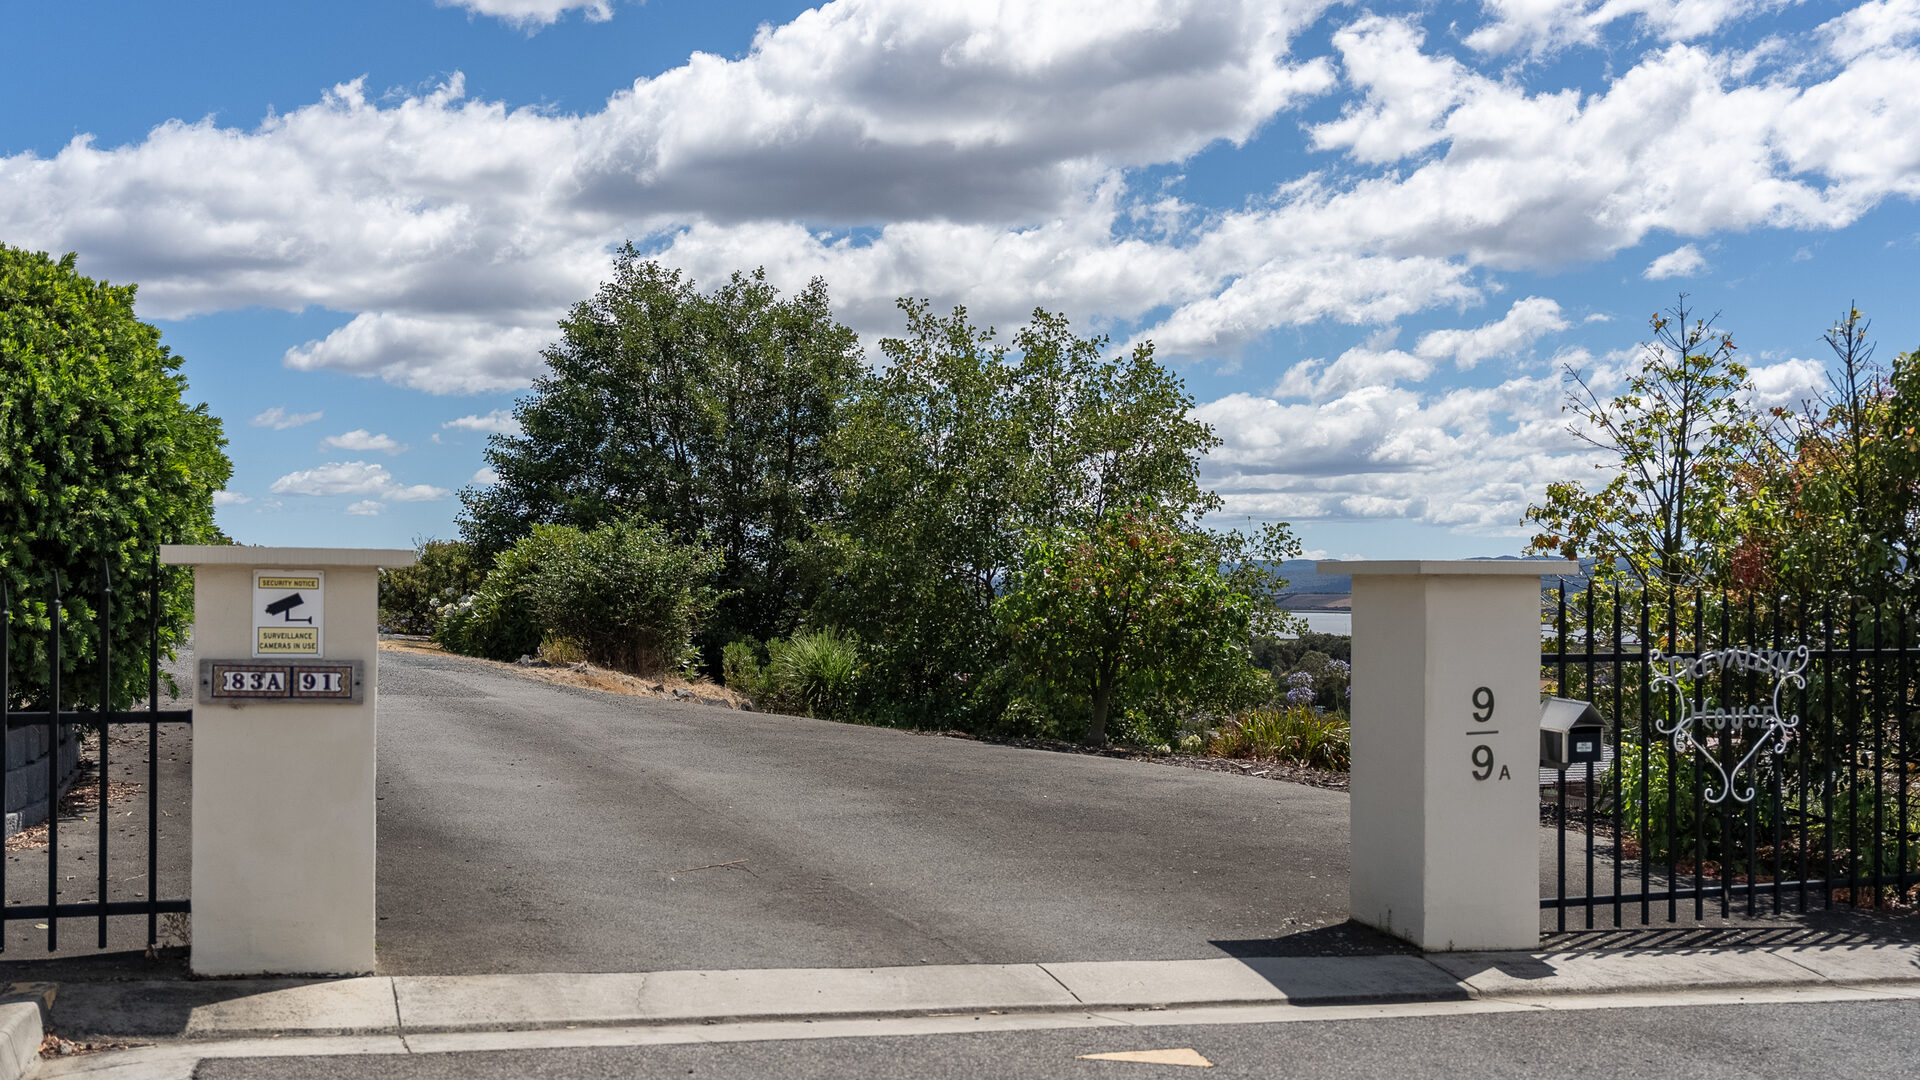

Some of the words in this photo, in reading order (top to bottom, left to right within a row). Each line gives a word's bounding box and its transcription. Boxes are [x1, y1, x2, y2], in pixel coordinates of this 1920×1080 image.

[263, 632, 313, 640] SURVEILLANCE
[259, 642, 291, 650] CAMERAS
[293, 642, 301, 650] IN
[302, 642, 316, 650] USE
[1661, 645, 1796, 683] TREVALLYN
[231, 673, 281, 690] 83A
[303, 673, 331, 690] 91
[1472, 686, 1495, 723] 9
